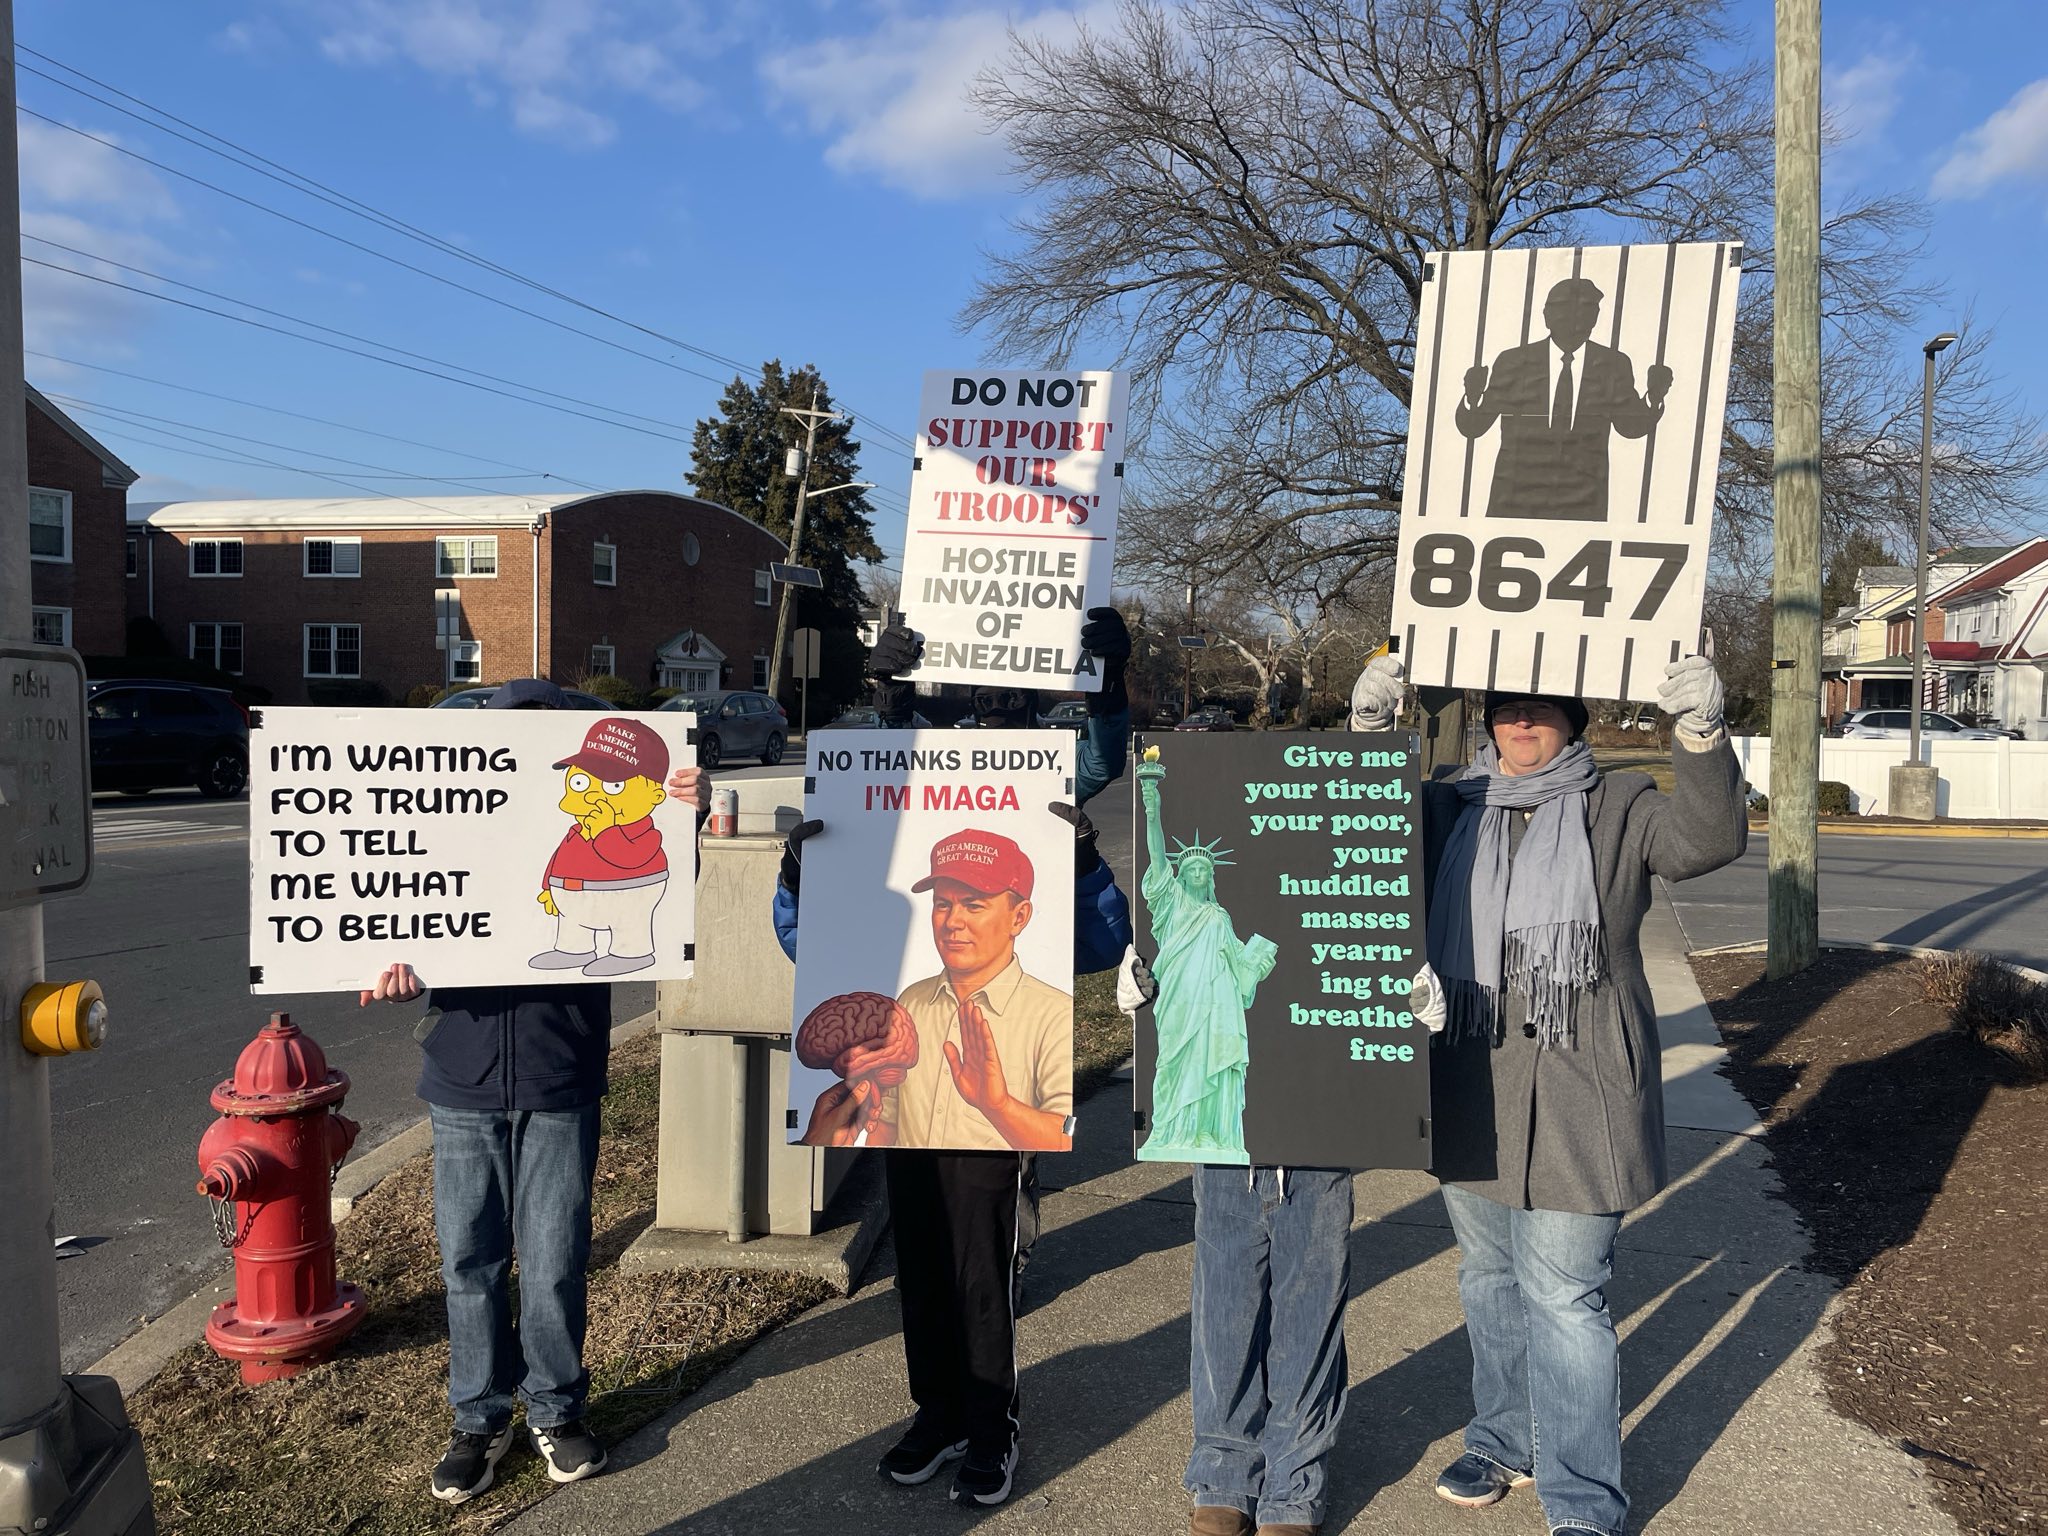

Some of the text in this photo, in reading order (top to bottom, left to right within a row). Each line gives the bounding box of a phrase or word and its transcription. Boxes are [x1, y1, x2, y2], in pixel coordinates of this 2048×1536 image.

[951, 378, 1096, 408] DO NOT
[927, 418, 1112, 452] SUPPORT
[976, 456, 1058, 487] OUR
[934, 492, 1100, 525] TROOPS'
[942, 548, 1076, 577] HOSTILE
[1410, 532, 1689, 621] 8647
[922, 578, 1084, 610] INVASION
[976, 611, 1022, 638] OF
[924, 642, 1097, 676] ENEZUELA
[13, 673, 50, 698] PUSH
[16, 717, 68, 741] UTTON
[606, 724, 637, 742] MAKE
[586, 740, 640, 767] DUMB AGAIN
[596, 733, 637, 754] AMERICA
[817, 750, 1063, 775] NO THANKS BUDDY,
[1283, 745, 1407, 768] Give me
[271, 787, 352, 814] FOR
[865, 785, 1020, 811] I'M MAGA
[1244, 778, 1412, 805] your tired,
[1250, 815, 1412, 836] your poor,
[270, 828, 428, 857] TO TELL
[936, 842, 999, 857] MAKE AMERICA
[937, 852, 995, 865] GREAT AGAIN
[1333, 847, 1408, 869] your
[351, 870, 470, 899] WHAT
[1280, 874, 1410, 896] huddled
[270, 912, 492, 943] TO BELIEVE
[1301, 911, 1410, 929] masses
[1311, 943, 1412, 964] yearn-
[1321, 971, 1413, 996] ing to
[1290, 1003, 1413, 1028] breathe
[1349, 1038, 1414, 1061] free
